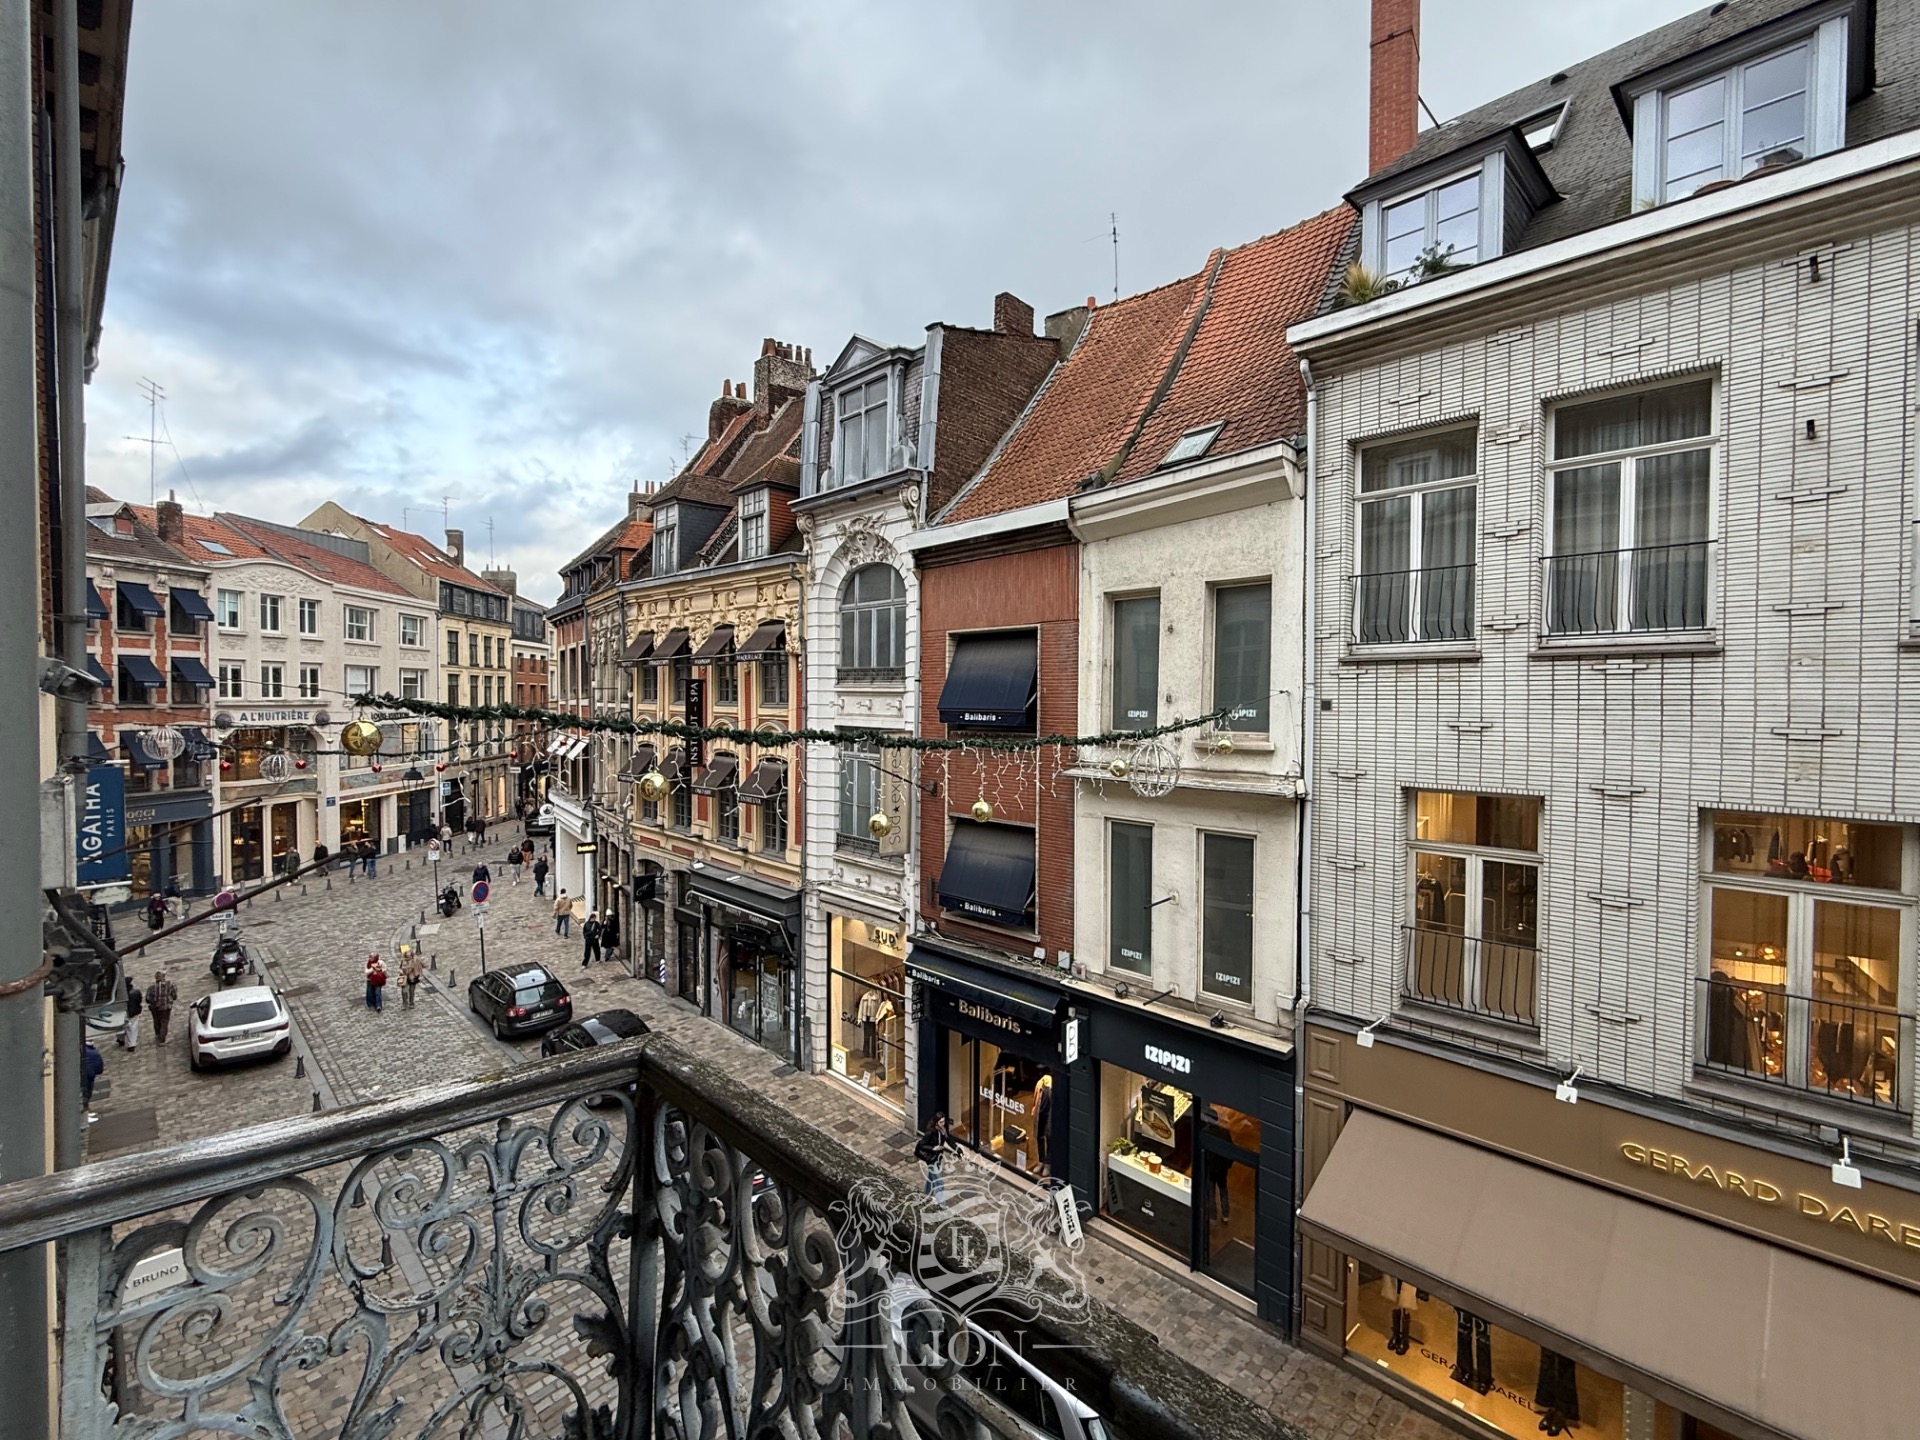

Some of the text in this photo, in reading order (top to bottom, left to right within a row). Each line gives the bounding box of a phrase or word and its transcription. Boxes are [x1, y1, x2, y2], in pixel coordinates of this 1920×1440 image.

[690, 682, 699, 703] SPA
[239, 712, 249, 721] A
[964, 713, 996, 721] Balibaris
[1127, 710, 1149, 718] IZIPIZI
[690, 716, 698, 765] INSTUT
[891, 748, 902, 804] expres
[106, 808, 115, 837] PARIS
[964, 902, 996, 917] Balibaris
[1121, 948, 1142, 960] IZIPIZI
[911, 970, 941, 986] Balibaris
[1215, 972, 1241, 986] IZIPIZI
[958, 1000, 1021, 1034] Balibaris
[1144, 1044, 1191, 1074] IZIPIZI
[979, 1085, 993, 1100] LES
[995, 1092, 1025, 1114] SOLDES
[1619, 1142, 1783, 1202] GERARD
[133, 1265, 179, 1288] BRUNO
[1420, 1348, 1458, 1370] GERA
